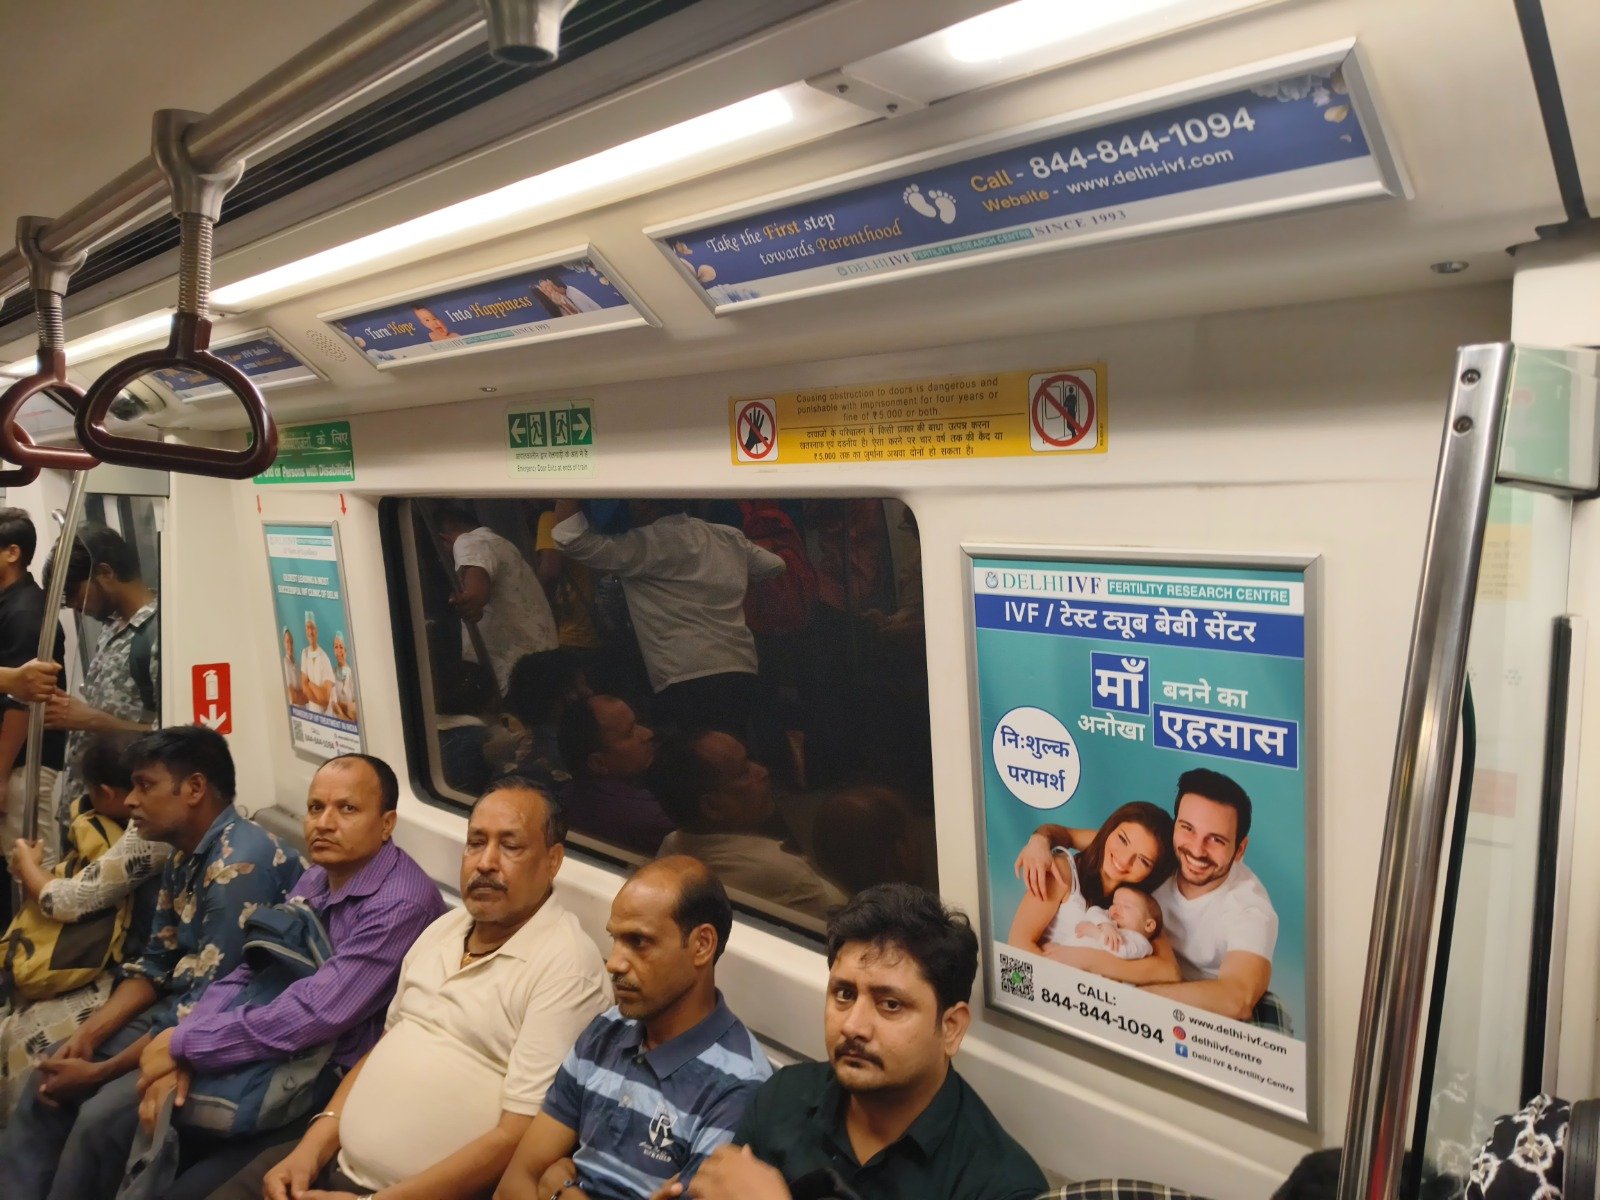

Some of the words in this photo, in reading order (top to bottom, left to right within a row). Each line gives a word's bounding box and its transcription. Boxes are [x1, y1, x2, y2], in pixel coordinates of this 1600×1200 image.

[970, 168, 1014, 194] Call
[1028, 106, 1256, 180] 844-844-1094
[982, 188, 1050, 213] Website
[1066, 146, 1235, 196] www.delhi-ivf.com
[705, 237, 740, 254] Take
[741, 228, 763, 246] the
[763, 220, 801, 241] First
[803, 213, 836, 232] step
[1034, 217, 1087, 237] SINCE
[1091, 210, 1128, 225] 1993
[759, 239, 816, 266] towards
[815, 218, 903, 252] Parenthood
[364, 326, 391, 340] Turn
[386, 320, 416, 337] Hope
[445, 309, 472, 323] Into
[469, 296, 533, 319] Happiness
[796, 393, 827, 404] Causing
[829, 389, 874, 401] obstruction
[877, 388, 886, 397] to
[890, 385, 913, 395] doors
[916, 384, 924, 393] is
[928, 379, 976, 392] dangerous
[980, 377, 999, 387] and
[797, 402, 838, 415] punishable
[841, 402, 857, 411] with
[860, 396, 917, 411] imprisonment
[920, 395, 932, 404] for
[936, 394, 955, 403] four
[958, 392, 984, 404] years
[988, 391, 999, 399] or
[830, 428, 836, 437] के
[878, 424, 894, 435] किसी
[917, 422, 925, 431] की
[971, 420, 990, 429] करना
[843, 412, 858, 421] fine
[861, 412, 869, 420] of
[906, 409, 915, 417] or
[331, 429, 348, 446] लिए
[839, 451, 851, 459] तक
[852, 451, 861, 459] का
[887, 449, 906, 458] अथवा
[928, 445, 936, 457] हो
[940, 446, 961, 456] सकता
[888, 434, 903, 446] करने
[907, 436, 916, 445] पर
[920, 435, 932, 444] चार
[936, 433, 946, 443] वर्ष
[950, 433, 963, 443] तक
[965, 431, 975, 442] की
[994, 431, 1003, 440] या
[282, 466, 305, 477] Persons
[1109, 581, 1164, 597] FERTILITY
[1166, 584, 1233, 600] RESEARCH
[1236, 587, 1288, 603] CENTRE
[1004, 601, 1039, 625] IVF
[1045, 604, 1055, 627] /
[1059, 600, 1097, 629] टेस्ट
[1102, 609, 1149, 641] ट्यूब
[1154, 606, 1198, 639] बेबी
[1203, 611, 1257, 644] सेंटर
[1095, 657, 1146, 709] माँ
[1162, 677, 1211, 704] बनने
[1217, 685, 1249, 709] का
[1077, 711, 1146, 742] अनोखा
[1158, 709, 1288, 757] एहसास
[1007, 762, 1067, 792] परामर्श
[1077, 982, 1118, 1007] CALL:
[1040, 987, 1165, 1044] 844-844-1094
[1188, 1016, 1288, 1055] www.delhi-ivf.com
[1191, 1034, 1262, 1066] delhiivfcentre
[1192, 1050, 1212, 1063] Delhi
[1213, 1058, 1226, 1068] IVF
[1234, 1065, 1265, 1084] Fertility
[1266, 1078, 1295, 1093] Centre
